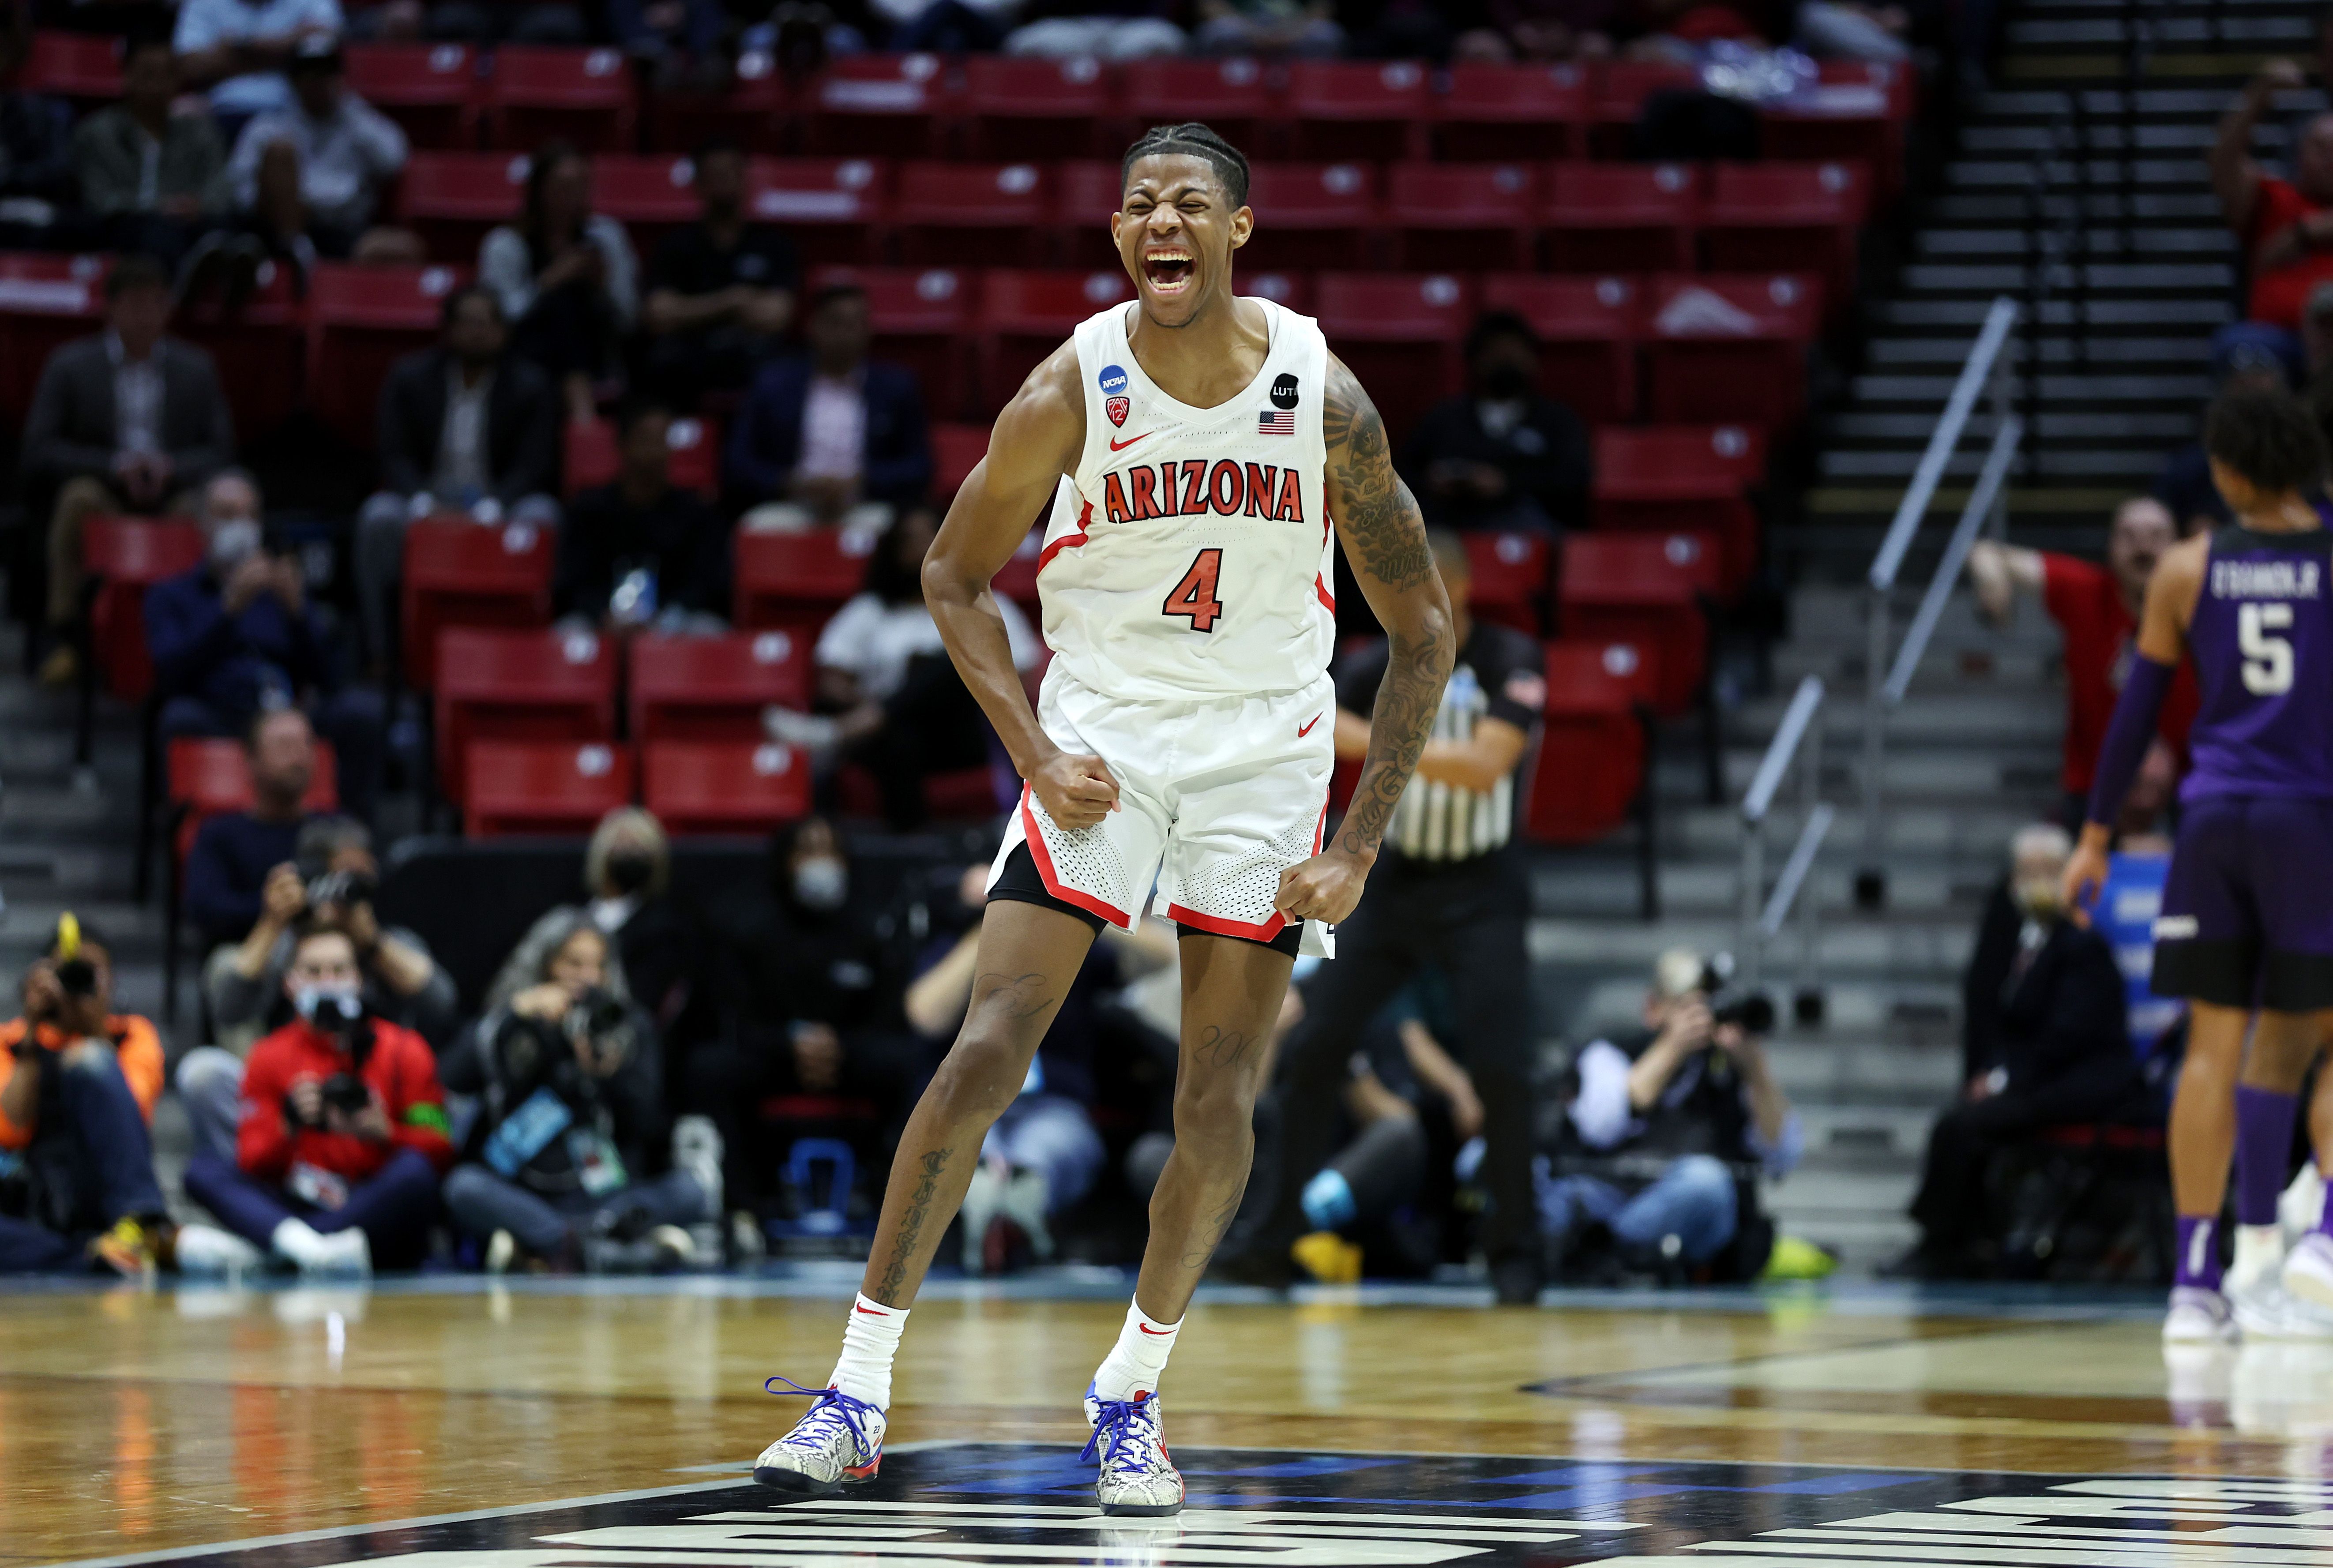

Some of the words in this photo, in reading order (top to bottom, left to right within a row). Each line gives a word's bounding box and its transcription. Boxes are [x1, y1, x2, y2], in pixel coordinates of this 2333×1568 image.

[1103, 375, 1126, 389] NCAA
[1107, 398, 1128, 415] PAC
[1112, 409, 1123, 421] 12
[1104, 459, 1304, 524] ARIZONA
[1162, 548, 1223, 634] 4
[2237, 601, 2294, 697] 5
[873, 1425, 880, 1434] 23
